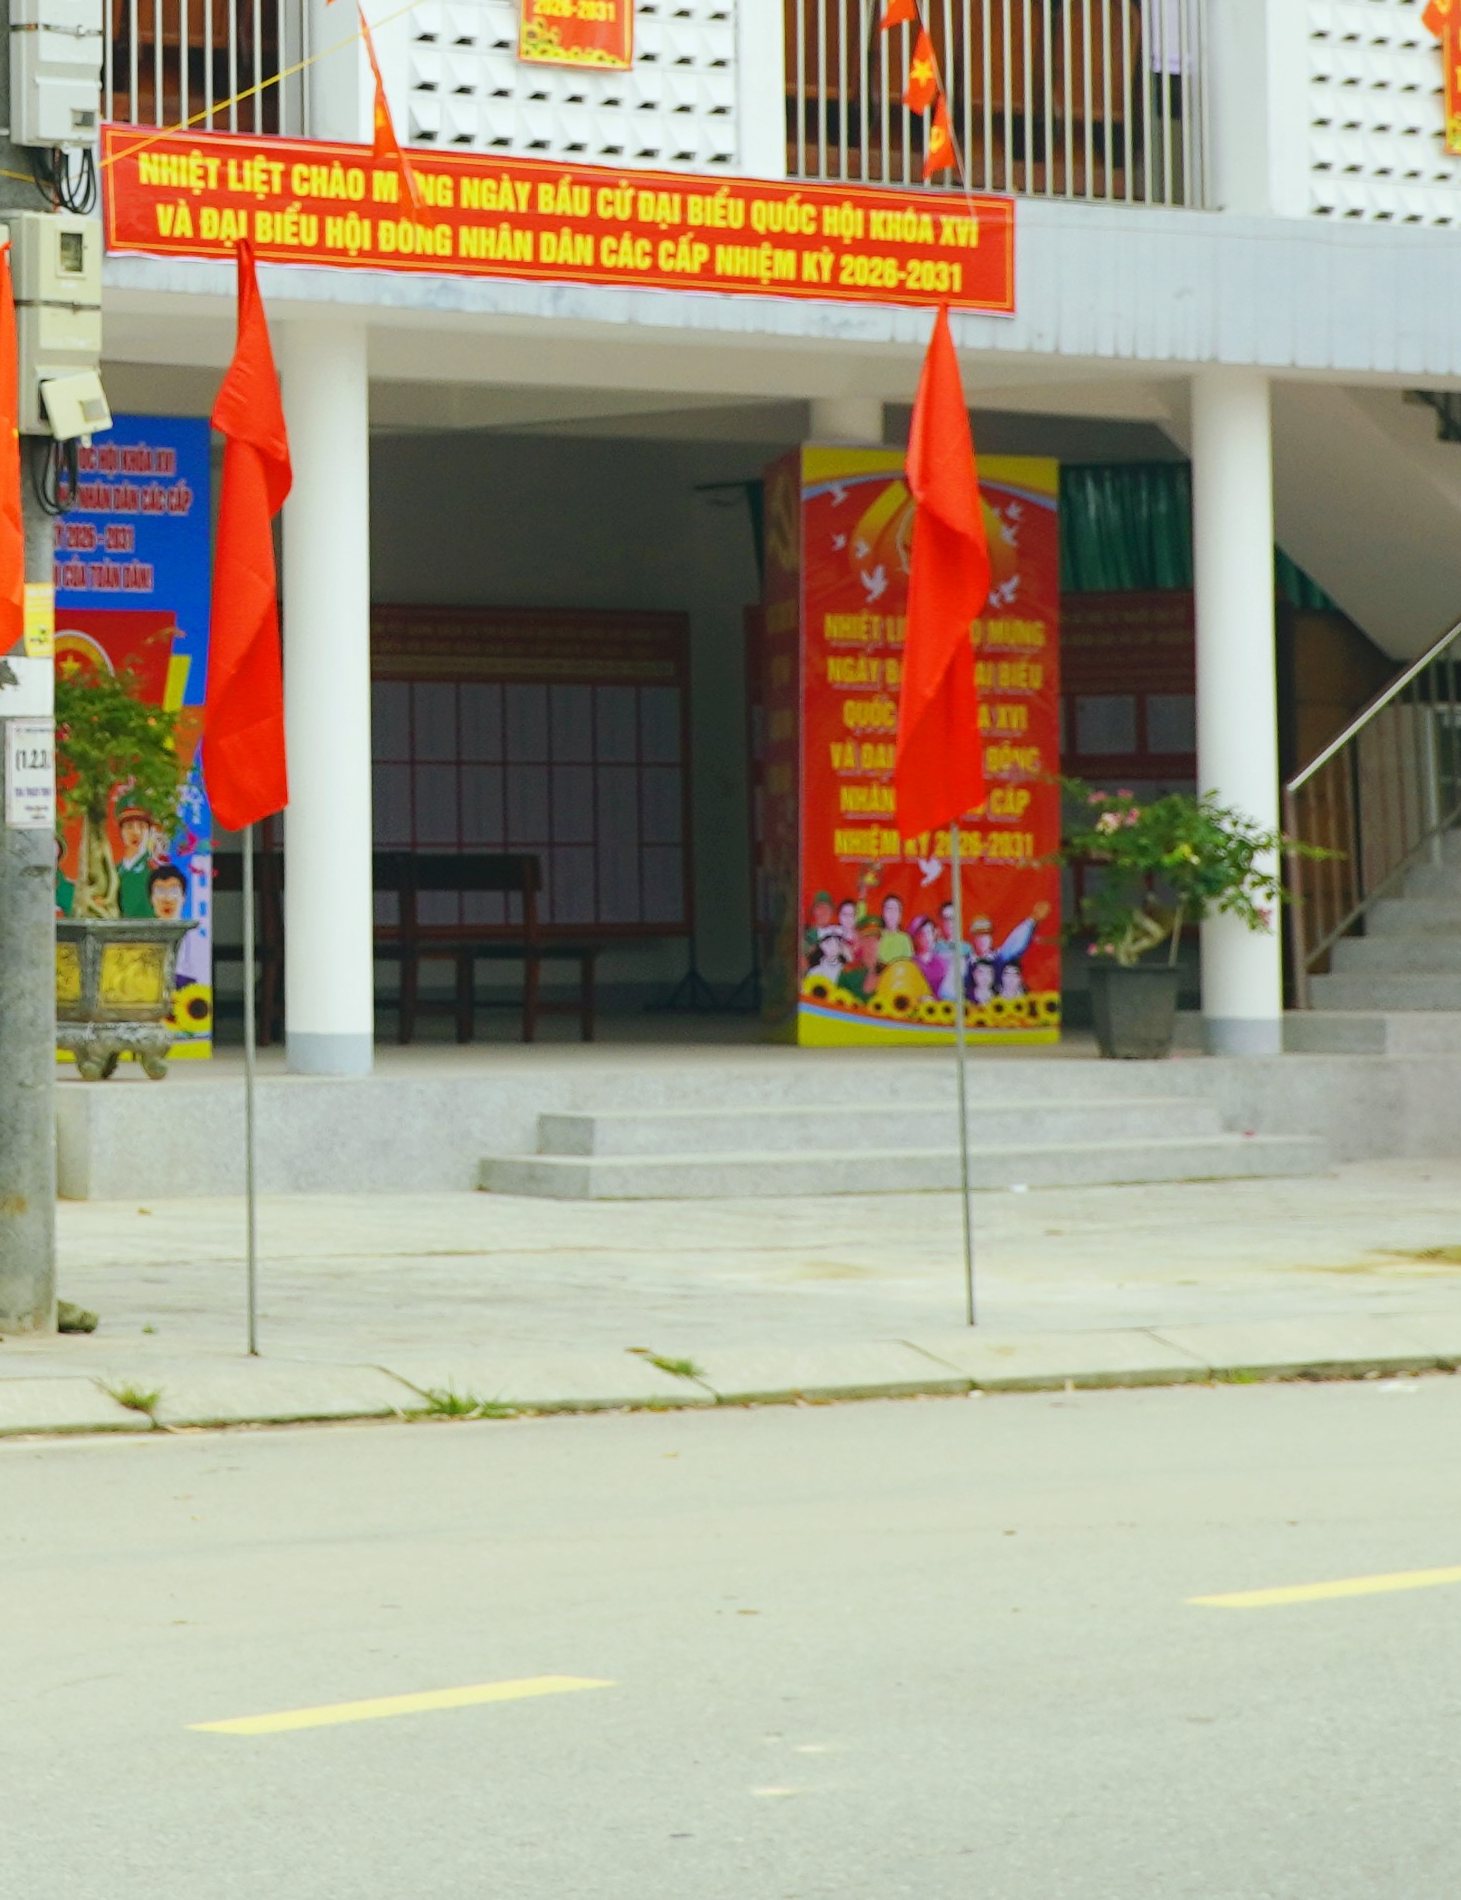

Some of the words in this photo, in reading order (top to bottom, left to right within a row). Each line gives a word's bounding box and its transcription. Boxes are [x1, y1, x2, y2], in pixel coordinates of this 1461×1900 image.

[138, 149, 220, 195] NHIỆT
[228, 154, 284, 200] LIỆT
[291, 160, 365, 200] CHÀO
[372, 170, 454, 207] MNG
[460, 173, 532, 213] NGÀY
[596, 180, 635, 220] CỬ
[637, 190, 681, 230] ĐẠI
[687, 185, 745, 229] BIỂU
[751, 193, 817, 235] QUỐC
[822, 201, 864, 244] HỘI
[870, 207, 934, 244] KHÓA
[939, 215, 978, 248] XVI
[156, 199, 193, 238] VÀ
[200, 206, 247, 247] ĐẠI
[255, 201, 318, 246] BIỂU
[325, 211, 371, 256] HỘI
[459, 222, 533, 261] NHÂN
[540, 227, 594, 266] DÂN
[600, 231, 652, 270] CÁC
[658, 232, 709, 273] CẤP
[715, 241, 796, 285] NHIỆM
[802, 246, 835, 282] KỲ
[839, 255, 962, 292] 2026-2031
